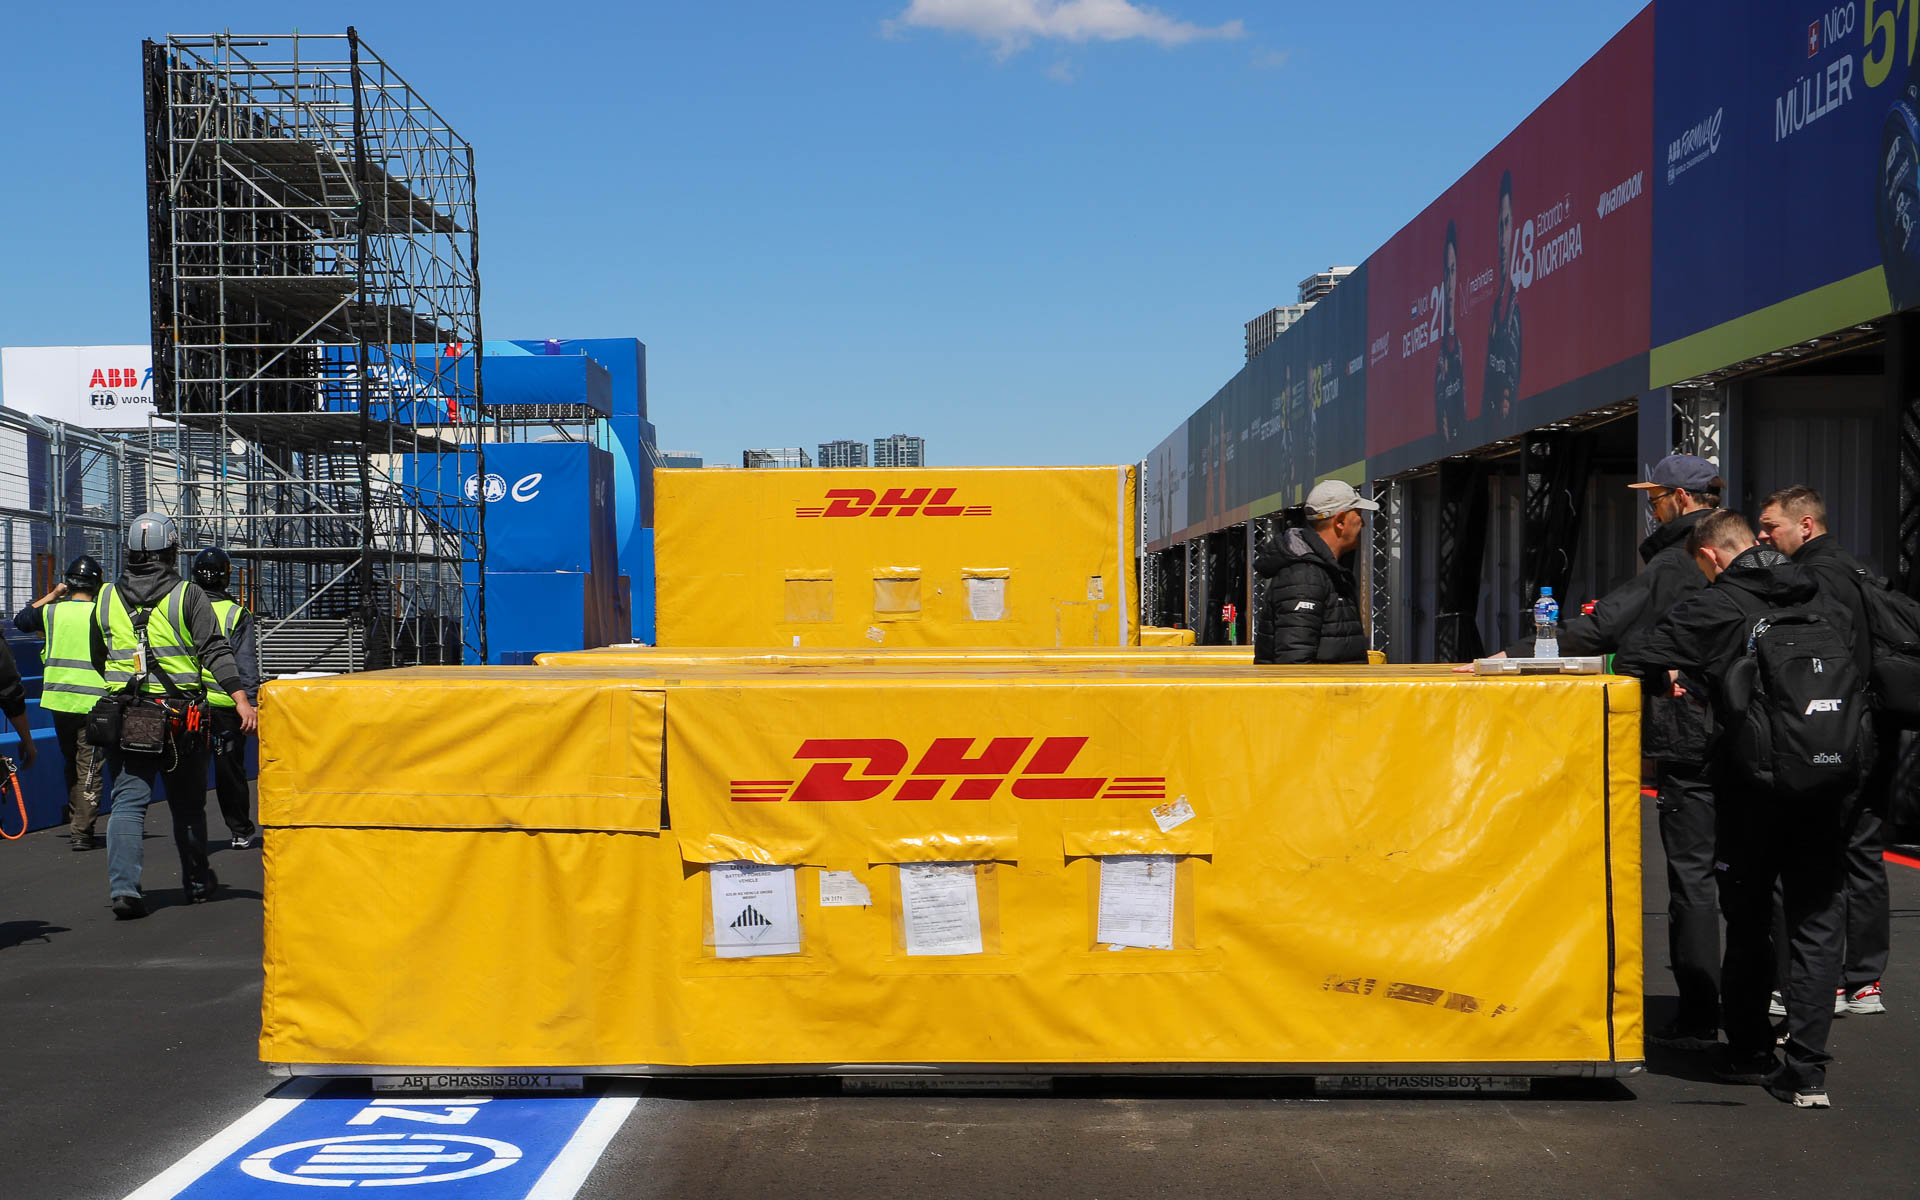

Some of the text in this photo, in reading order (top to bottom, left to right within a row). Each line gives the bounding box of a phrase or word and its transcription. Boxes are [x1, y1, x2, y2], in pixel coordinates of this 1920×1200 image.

[1863, 0, 1919, 87] 51
[1776, 54, 1853, 142] MÜLLER
[1511, 219, 1534, 293] 48
[1537, 223, 1583, 280] MORTARA
[1430, 281, 1445, 343] 21
[89, 368, 138, 388] ABB
[121, 396, 154, 404] WORL
[822, 487, 966, 518] DHL
[1805, 699, 1842, 716] ABT
[787, 736, 1109, 802] DHL
[402, 1076, 432, 1088] ABT
[437, 1076, 505, 1088] CHASSIS
[507, 1076, 540, 1088] BOX
[545, 1076, 552, 1088] 1
[1376, 1076, 1445, 1088] CHASSIS
[1448, 1076, 1481, 1088] BOX
[1487, 1076, 1493, 1088] 1
